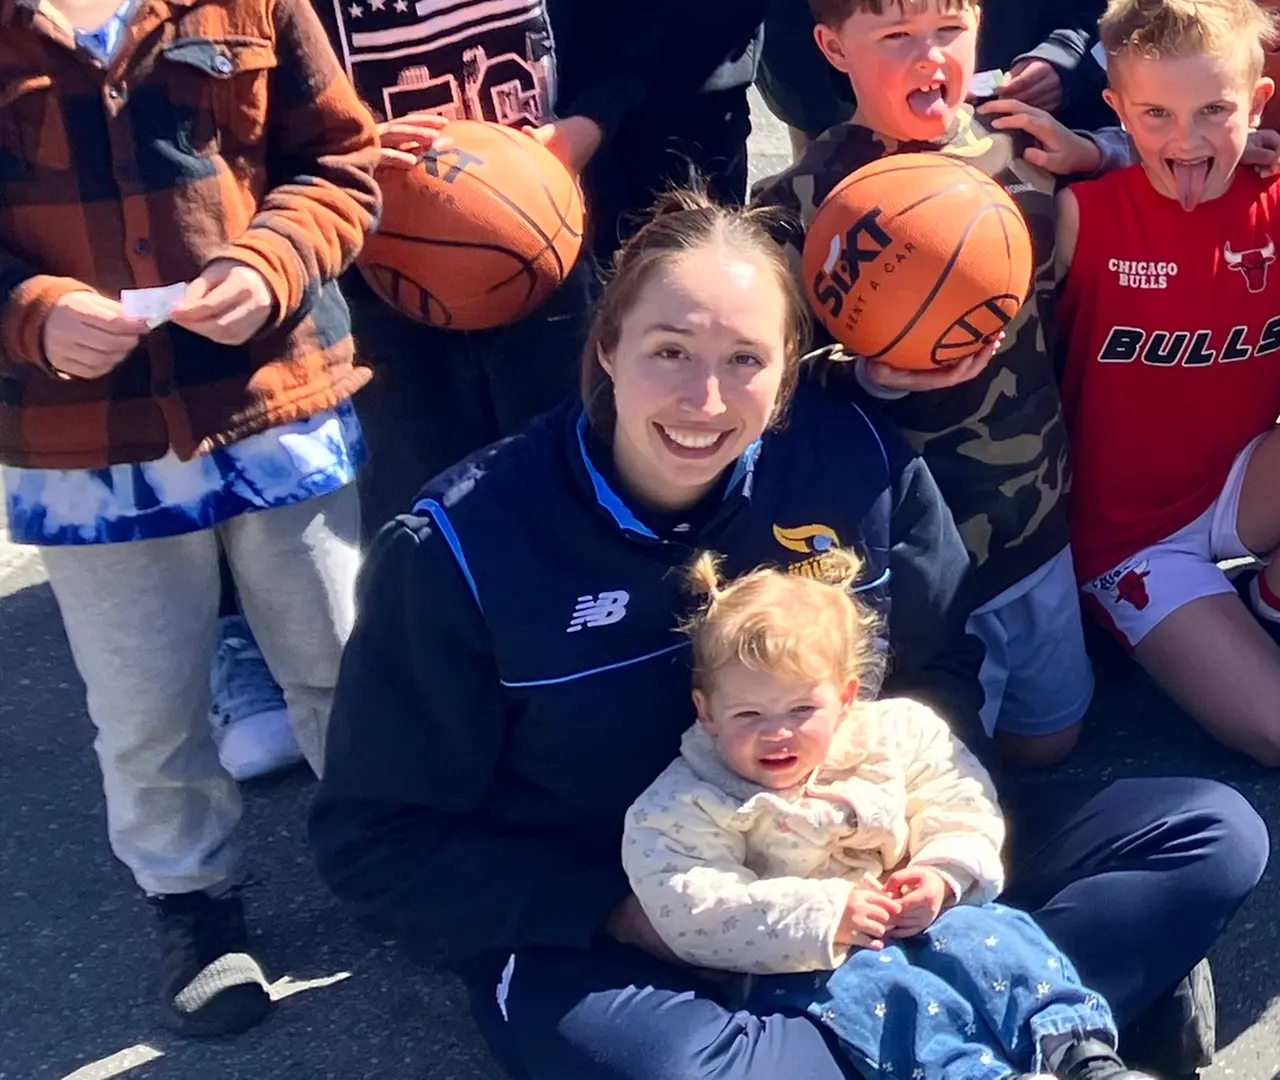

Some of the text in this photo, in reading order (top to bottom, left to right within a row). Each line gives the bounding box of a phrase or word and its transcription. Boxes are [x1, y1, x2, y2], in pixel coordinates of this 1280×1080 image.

[412, 147, 486, 184] XT
[813, 206, 894, 318] SIXT
[884, 241, 917, 274] CAR
[1108, 258, 1179, 276] CHICAGO
[1119, 273, 1168, 289] BULLS
[566, 589, 630, 633] NB
